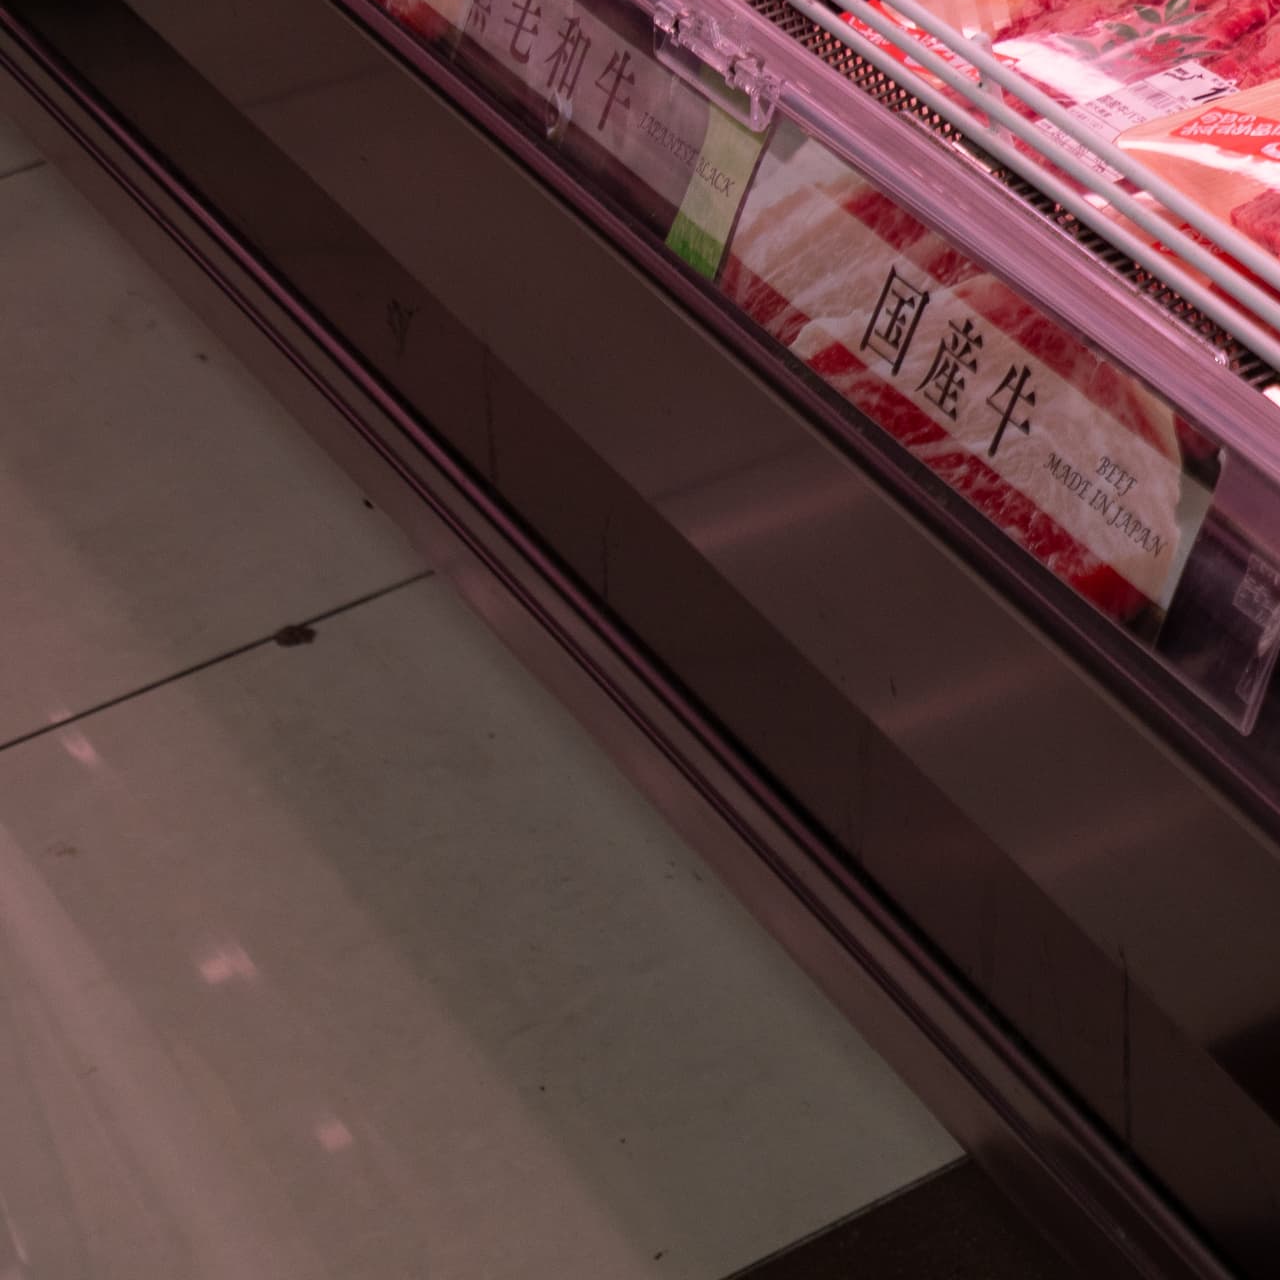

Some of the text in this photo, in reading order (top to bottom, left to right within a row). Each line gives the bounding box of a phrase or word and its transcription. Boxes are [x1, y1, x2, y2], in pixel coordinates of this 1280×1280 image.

[859, 267, 1040, 458] 国産牛
[1045, 452, 1168, 559] MADE IN JAPAN
[1098, 456, 1138, 495] BEEF
